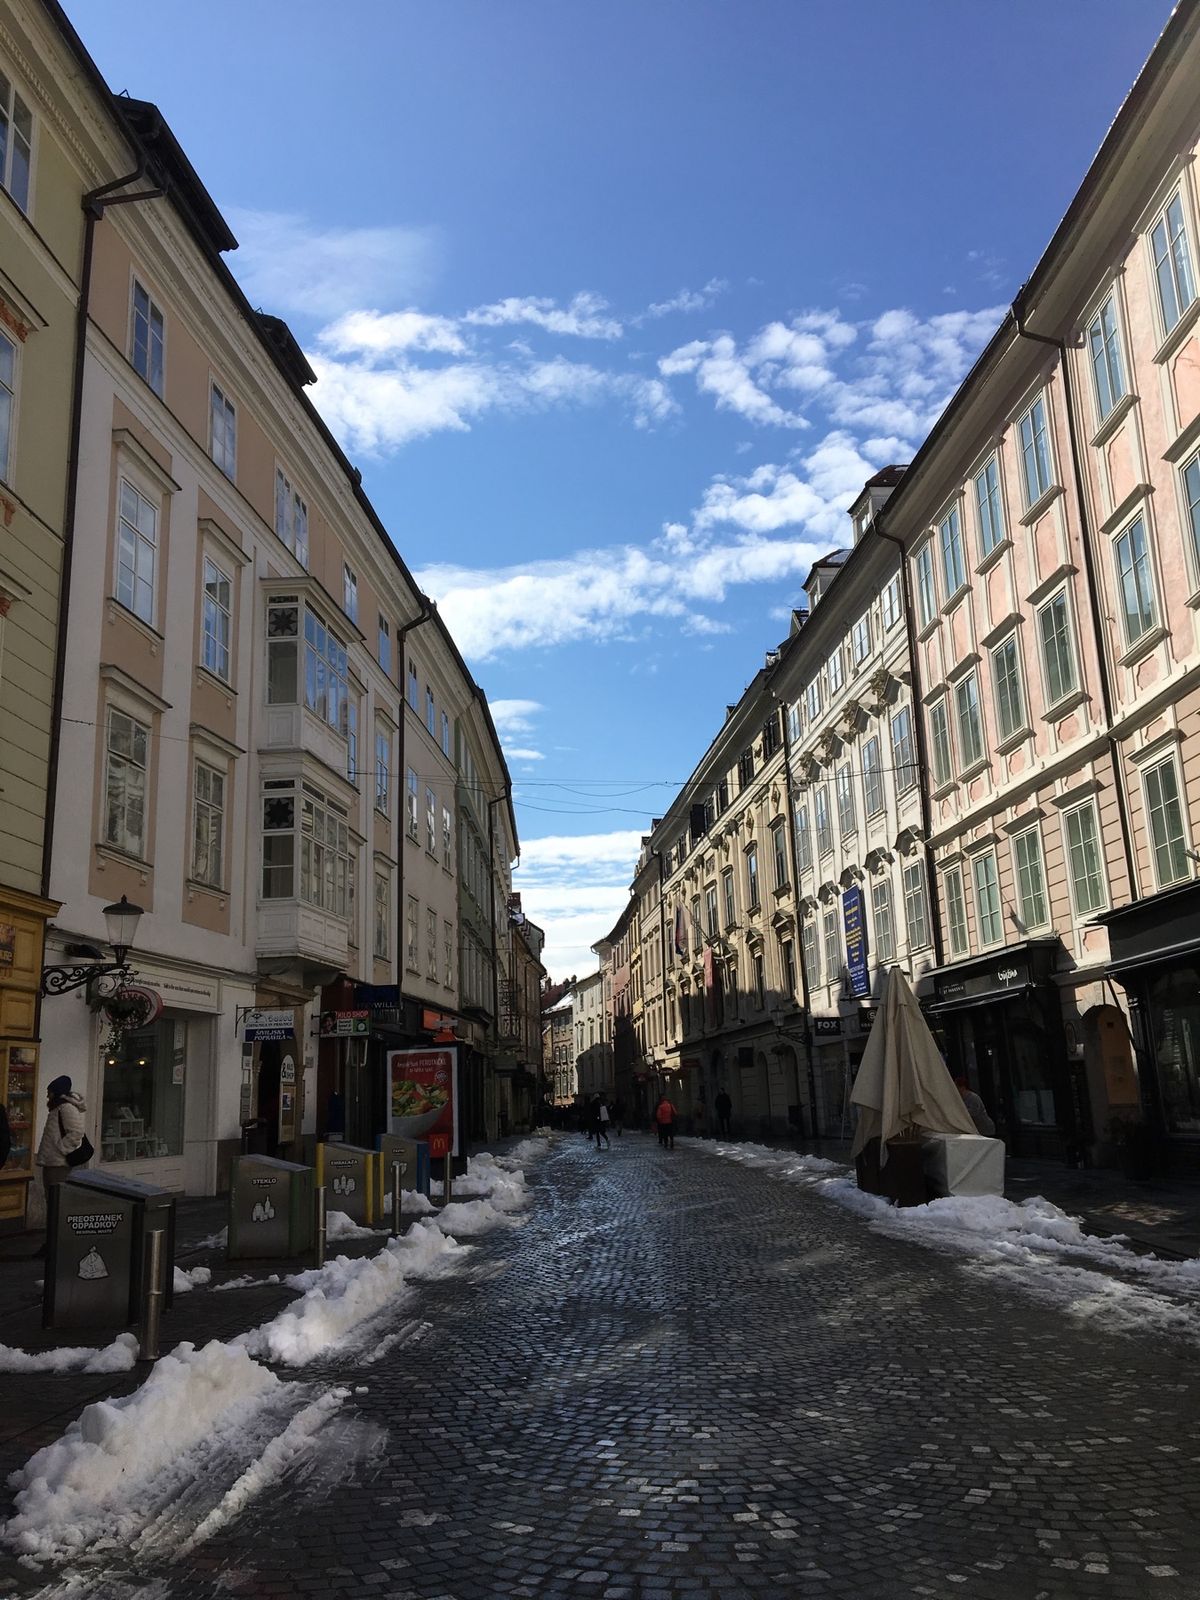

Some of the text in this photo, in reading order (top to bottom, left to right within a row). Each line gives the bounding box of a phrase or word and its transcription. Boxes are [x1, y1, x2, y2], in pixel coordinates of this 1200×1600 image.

[337, 1011, 352, 1019] KILO
[817, 1020, 838, 1030] FOX
[67, 1214, 123, 1223] PREOSTANEK
[72, 1221, 118, 1230] ODPADKOV
